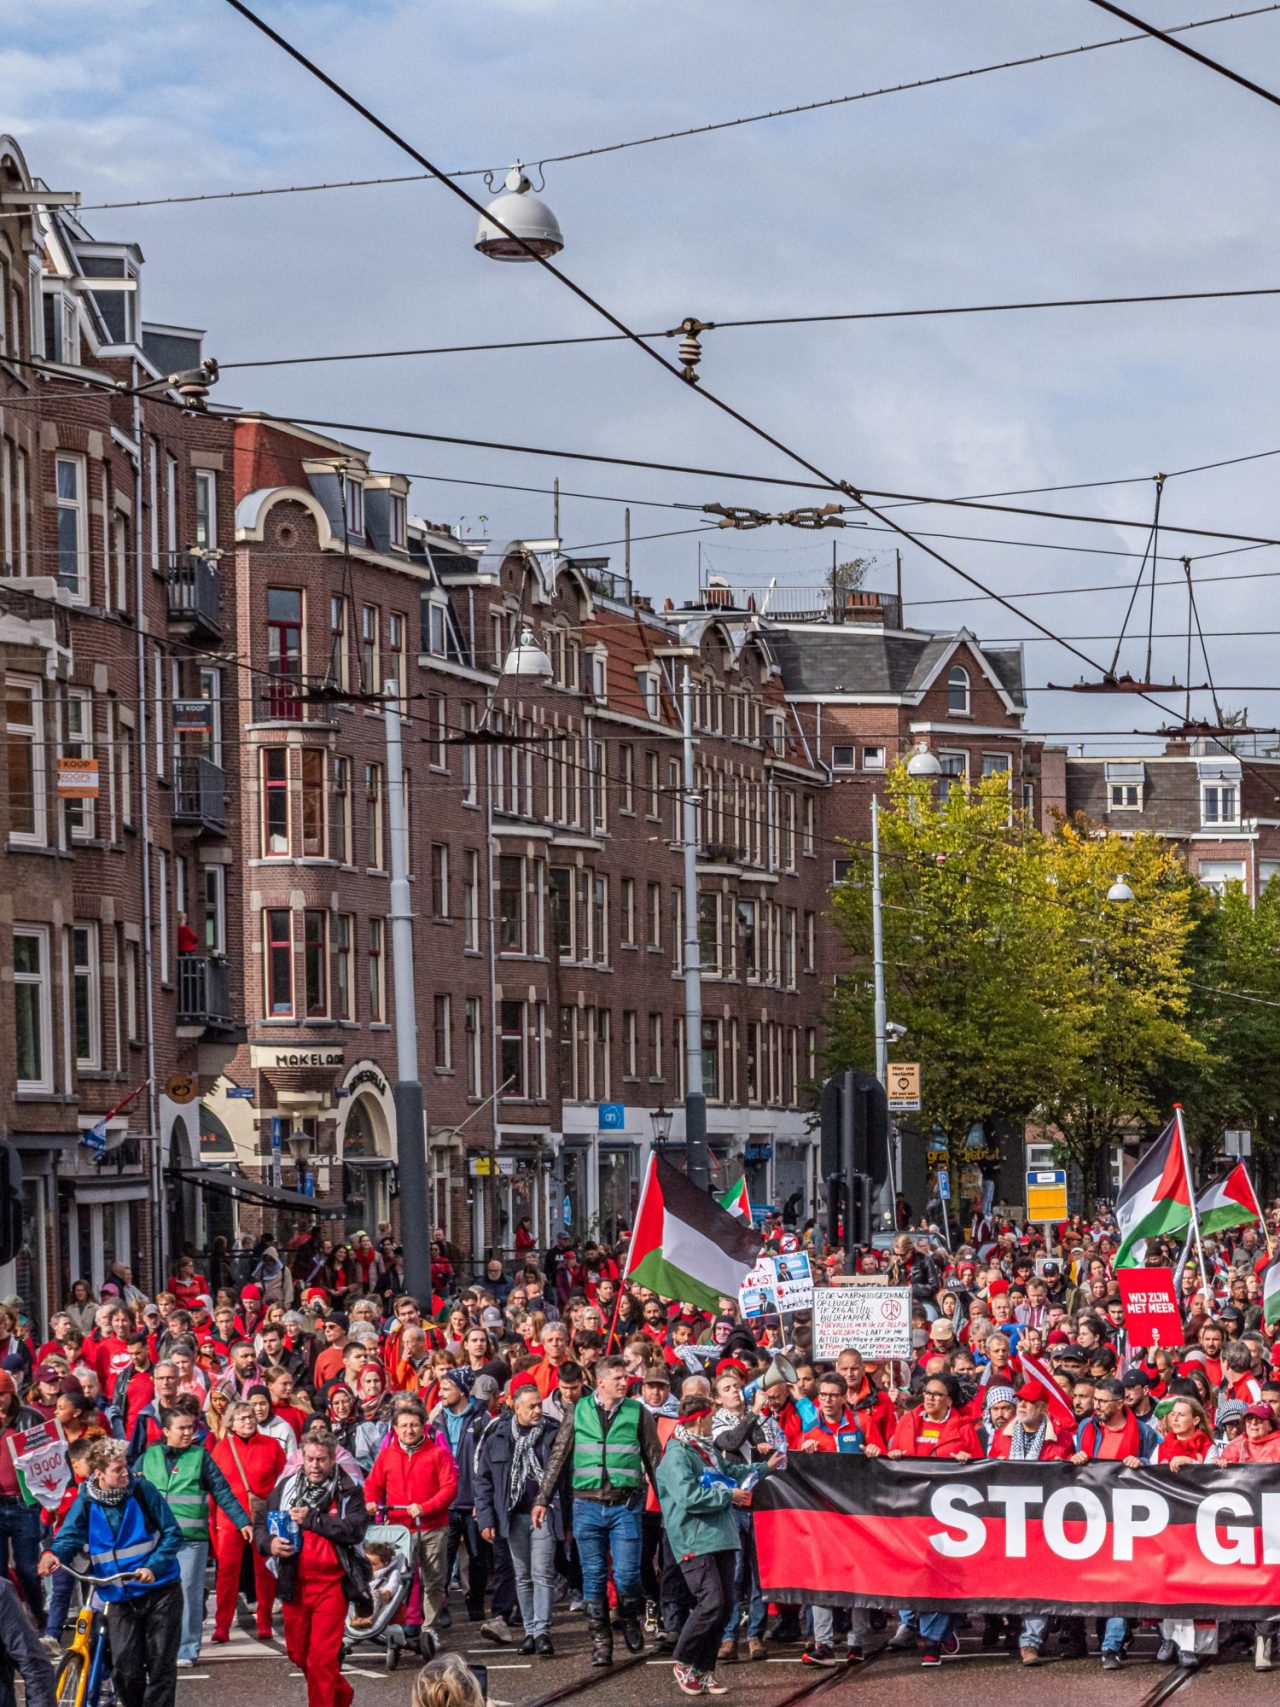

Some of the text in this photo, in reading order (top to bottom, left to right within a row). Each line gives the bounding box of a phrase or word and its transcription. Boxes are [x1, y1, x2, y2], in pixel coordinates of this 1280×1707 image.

[63, 760, 91, 769] KOOP
[1128, 1292, 1169, 1303] WIJ ZIJN
[1127, 1303, 1175, 1314] MET MEER
[29, 1452, 62, 1477] 19000
[929, 1485, 1170, 1561] STOP
